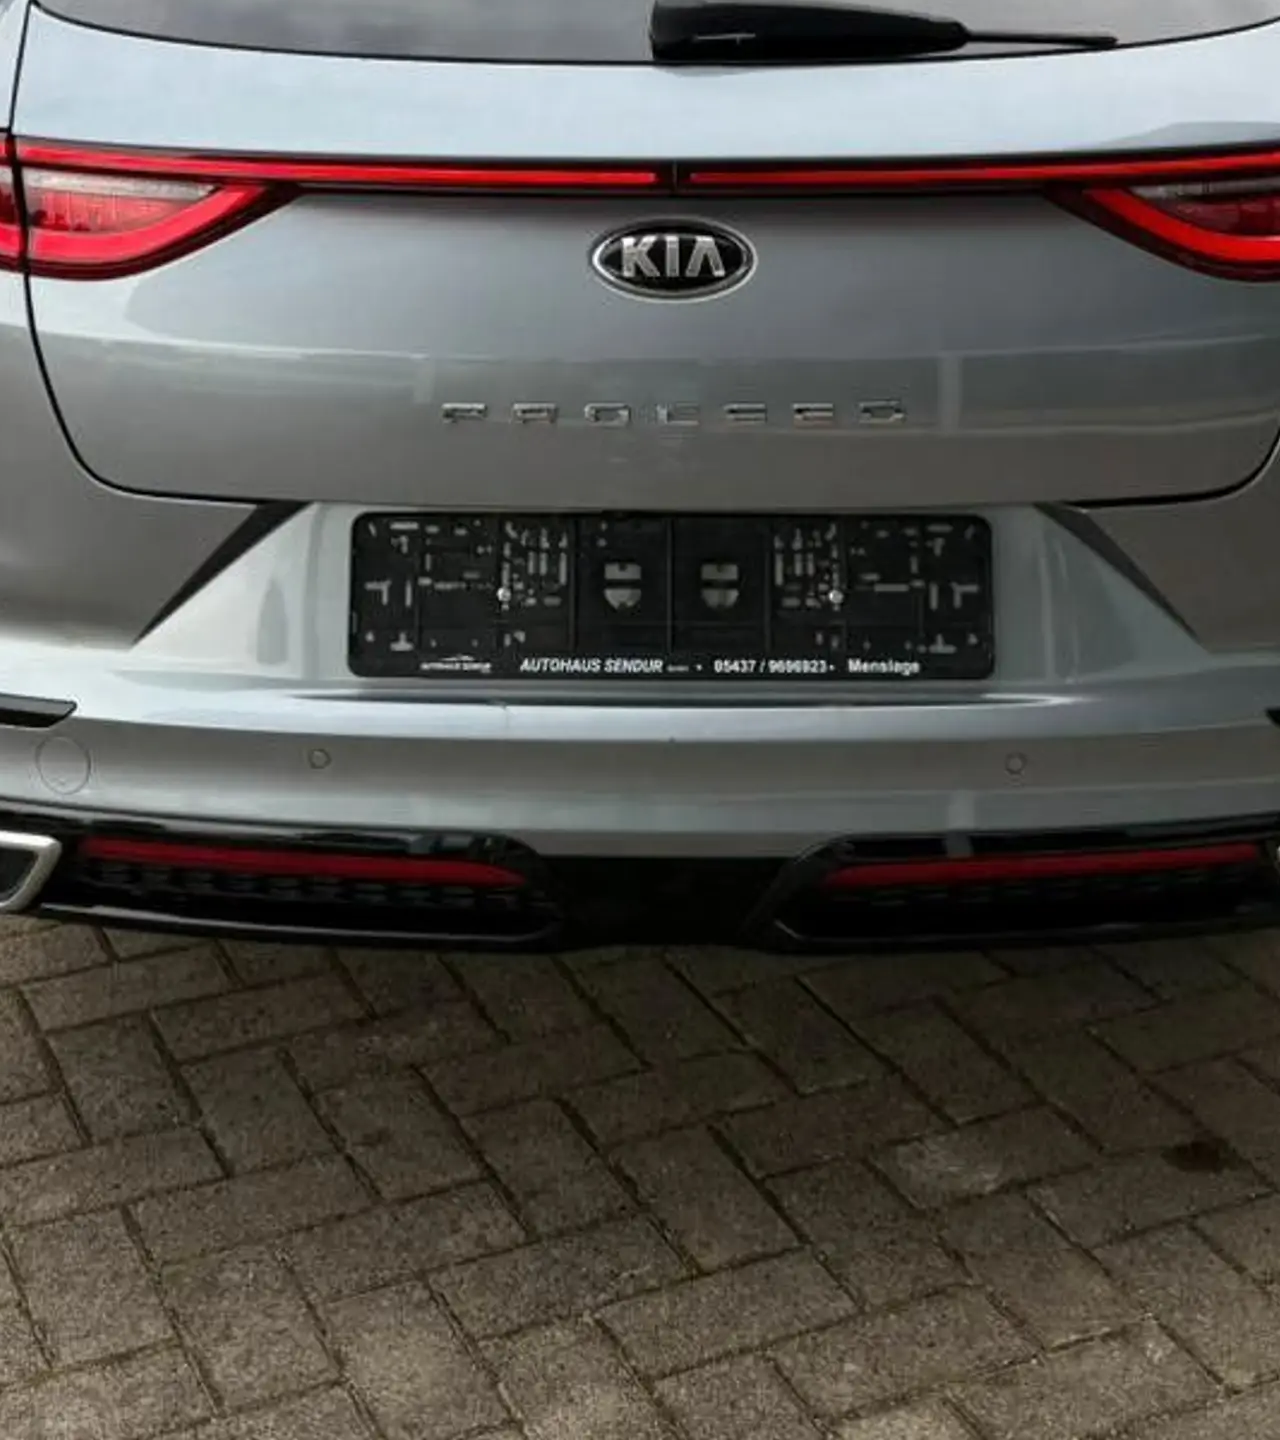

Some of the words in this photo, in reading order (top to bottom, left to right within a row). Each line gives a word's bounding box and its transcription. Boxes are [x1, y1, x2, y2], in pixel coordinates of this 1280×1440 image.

[621, 234, 726, 278] KIA
[440, 400, 907, 425] PROCEED
[520, 657, 602, 673] AUTOHAUS
[604, 657, 664, 673] SENDUR
[713, 658, 757, 674] 05437
